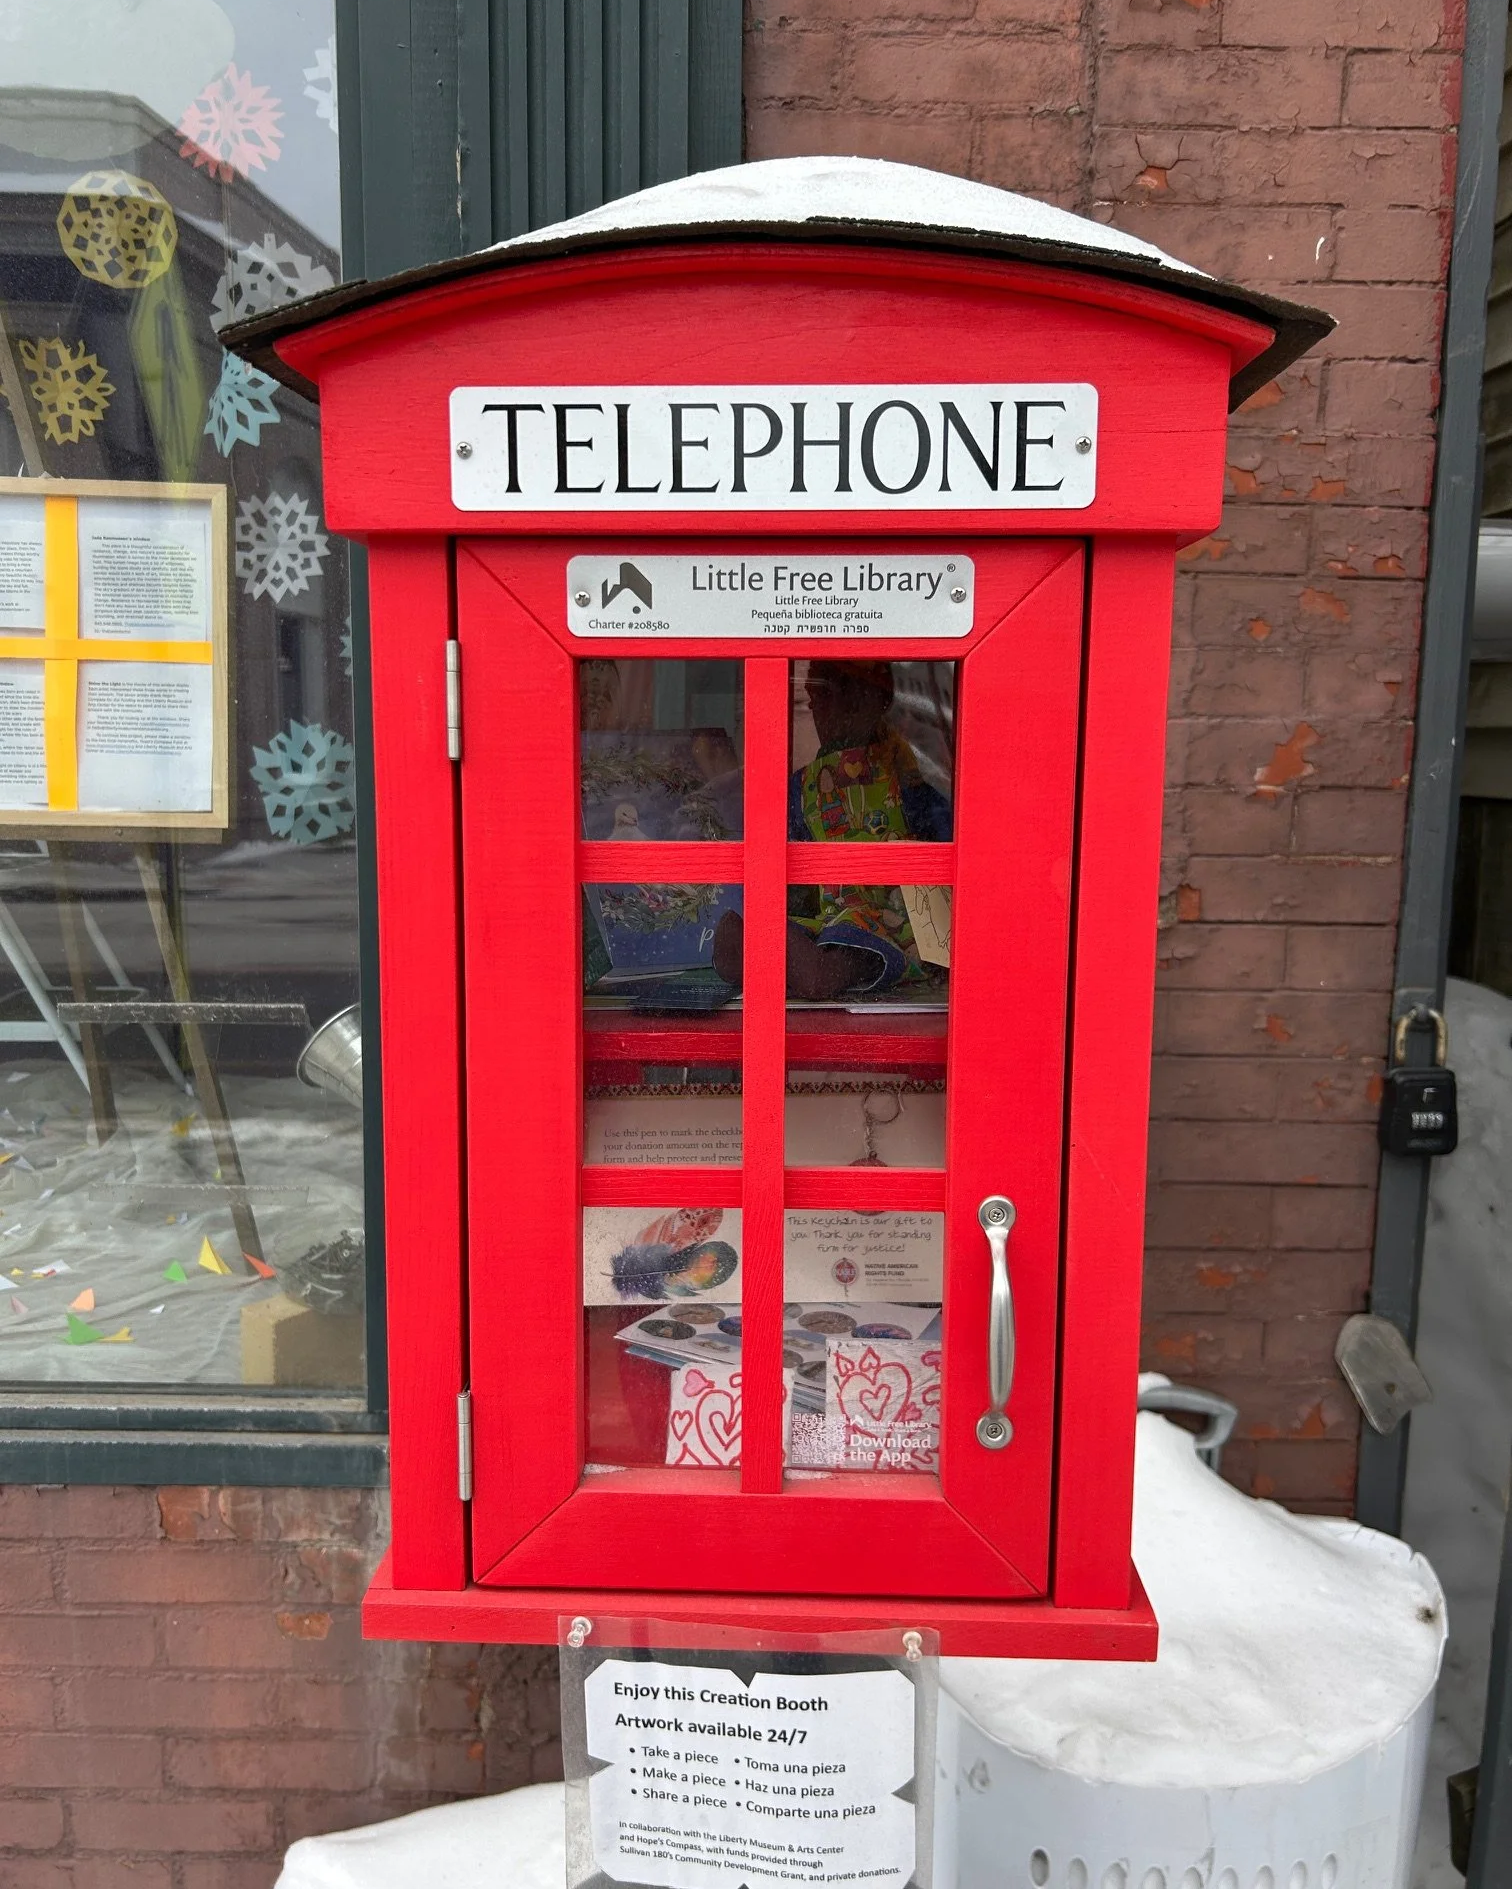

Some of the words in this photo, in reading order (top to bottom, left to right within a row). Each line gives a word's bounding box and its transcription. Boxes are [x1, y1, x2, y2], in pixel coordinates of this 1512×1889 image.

[482, 400, 1067, 494] TELEPHONE
[692, 563, 764, 591] Little
[773, 566, 833, 591] Free
[775, 596, 800, 606] Little
[802, 596, 822, 606] Free
[825, 596, 859, 608] Library
[751, 610, 793, 620] Pequeña
[795, 609, 842, 619] biblioteca
[844, 609, 883, 620] gratuita
[588, 618, 625, 629] Charter
[628, 620, 670, 632] #208580
[604, 1128, 620, 1138] Use
[623, 1128, 638, 1138] this
[641, 1130, 657, 1139] pen
[659, 1130, 669, 1138] to
[671, 1127, 692, 1137] mark
[695, 1127, 709, 1136] the
[603, 1144, 623, 1152] your
[625, 1140, 664, 1150] donation
[666, 1141, 700, 1149] amount
[701, 1141, 714, 1149] on
[715, 1140, 730, 1149] the
[603, 1155, 626, 1164] form
[628, 1154, 643, 1163] and
[646, 1154, 665, 1165] help
[667, 1154, 698, 1165] protect
[700, 1153, 717, 1162] and
[788, 1216, 808, 1226] This
[860, 1217, 870, 1225] is
[873, 1217, 891, 1225] our
[895, 1216, 916, 1227] gift
[920, 1217, 932, 1225] to
[814, 1230, 842, 1239] Thank
[847, 1231, 864, 1241] you
[867, 1230, 884, 1239] for
[887, 1231, 932, 1240] standing
[842, 1244, 857, 1252] for
[861, 1244, 905, 1255] justice!
[850, 1434, 932, 1448] Download
[850, 1449, 876, 1462] the
[879, 1450, 911, 1467] App
[614, 1682, 660, 1700] Enjoy
[664, 1686, 695, 1701] this
[699, 1689, 771, 1710] Creation
[776, 1696, 828, 1711] Booth
[615, 1713, 683, 1732] Artwork
[688, 1722, 762, 1741] available
[767, 1728, 808, 1746] 24/7
[642, 1746, 670, 1759] Take
[673, 1752, 681, 1761] a
[684, 1750, 719, 1764] piece
[745, 1757, 779, 1773] Toma
[783, 1763, 808, 1774] una
[812, 1761, 846, 1776] pieza
[642, 1767, 678, 1782] Make
[681, 1774, 689, 1783] a
[692, 1772, 726, 1787] piece
[642, 1787, 679, 1803] Share
[682, 1794, 690, 1804] a
[693, 1793, 728, 1809] piece
[745, 1779, 768, 1794] Haz
[772, 1786, 797, 1796] una
[801, 1785, 835, 1799] pieza
[746, 1800, 811, 1819] Comparte
[814, 1808, 839, 1819] una
[842, 1804, 876, 1818] pieza
[629, 1822, 681, 1836] collaboration
[683, 1830, 701, 1838] with
[703, 1832, 717, 1840] the
[719, 1834, 747, 1846] Liberty
[749, 1838, 785, 1852] Museum
[787, 1844, 795, 1853] &
[797, 1845, 814, 1854] Arts
[816, 1846, 845, 1855] Center
[620, 1833, 635, 1842] and
[665, 1839, 704, 1853] Compass,
[706, 1845, 725, 1854] with
[726, 1846, 750, 1858] funds
[750, 1851, 788, 1865] provided
[789, 1858, 823, 1869] through
[620, 1846, 651, 1857] Sullivan
[675, 1854, 722, 1868] Community
[724, 1860, 778, 1878] Development
[780, 1870, 807, 1881] Grant,
[808, 1873, 825, 1882] and
[826, 1872, 857, 1882] private
[859, 1866, 902, 1879] donations.
